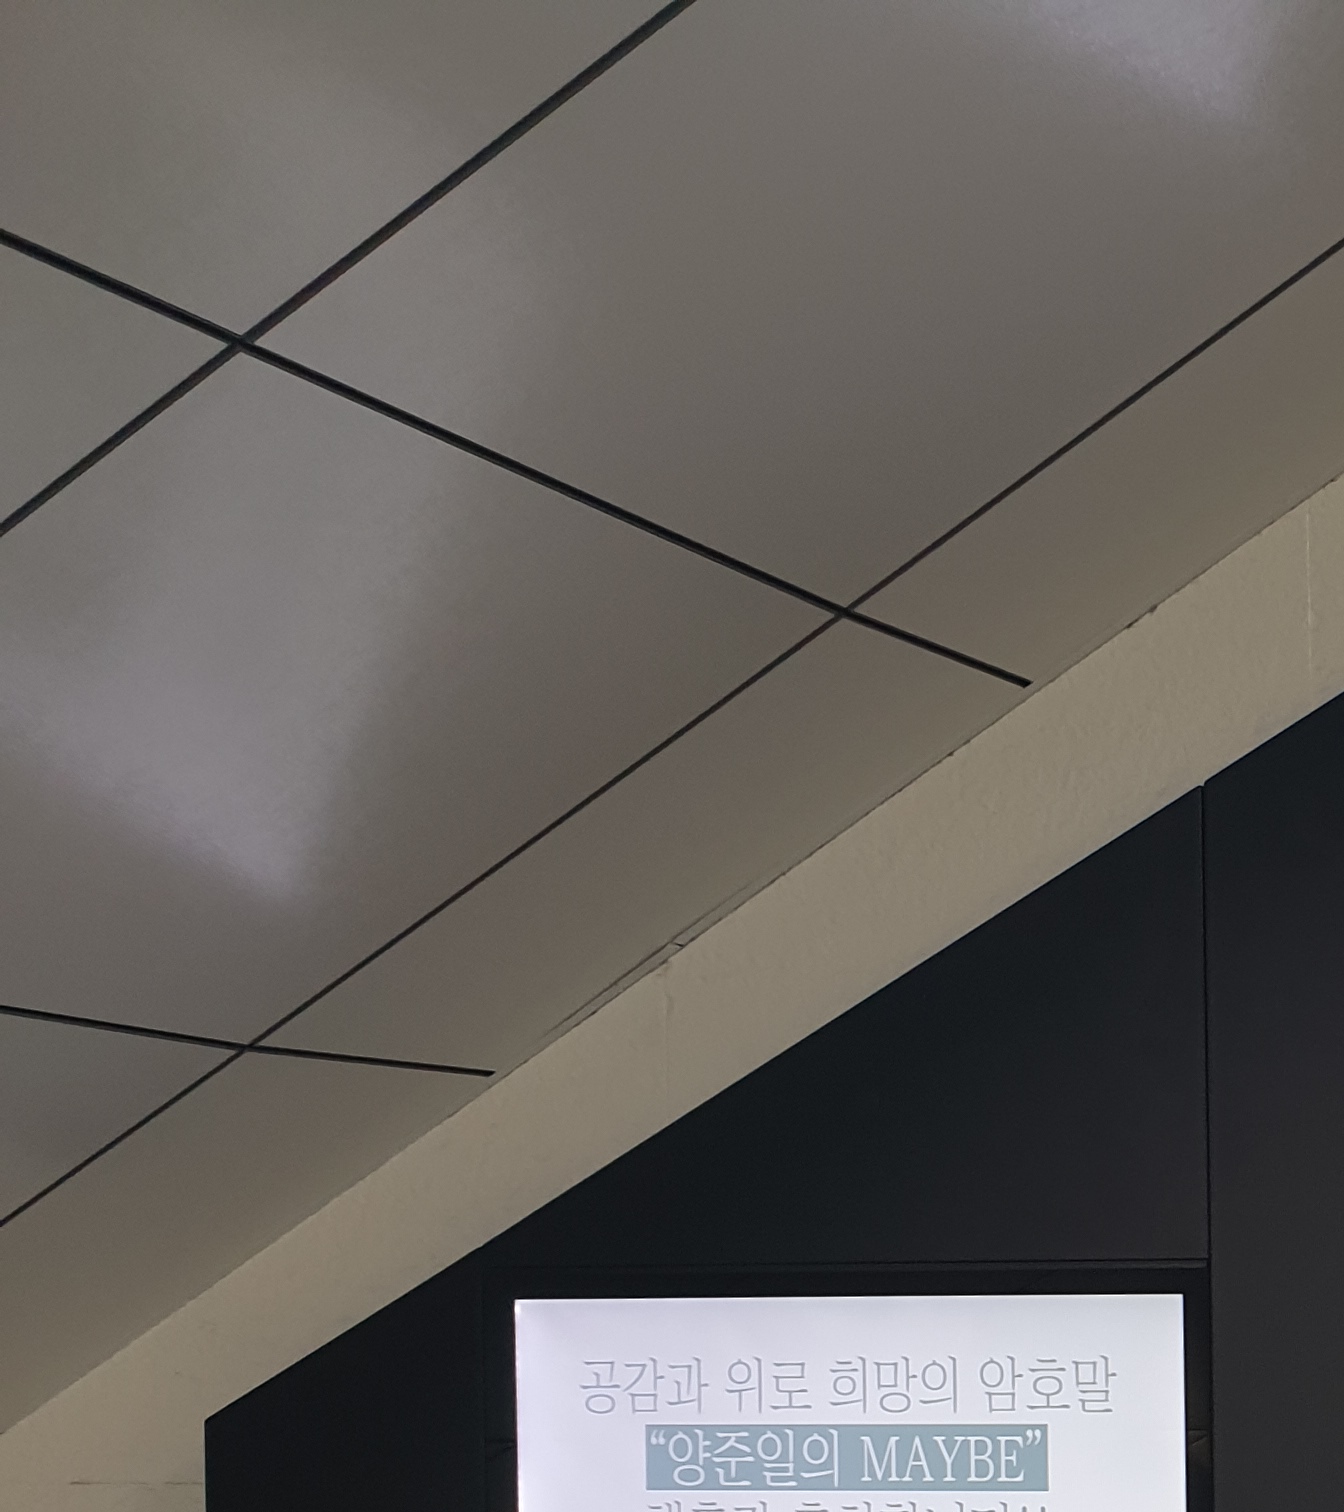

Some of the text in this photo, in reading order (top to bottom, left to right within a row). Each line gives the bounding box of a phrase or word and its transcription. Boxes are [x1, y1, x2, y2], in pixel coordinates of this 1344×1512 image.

[579, 1354, 1117, 1415] 공감과 위로 희망의 암호말
[650, 1429, 1041, 1486] “양준일의 MAYBE”
